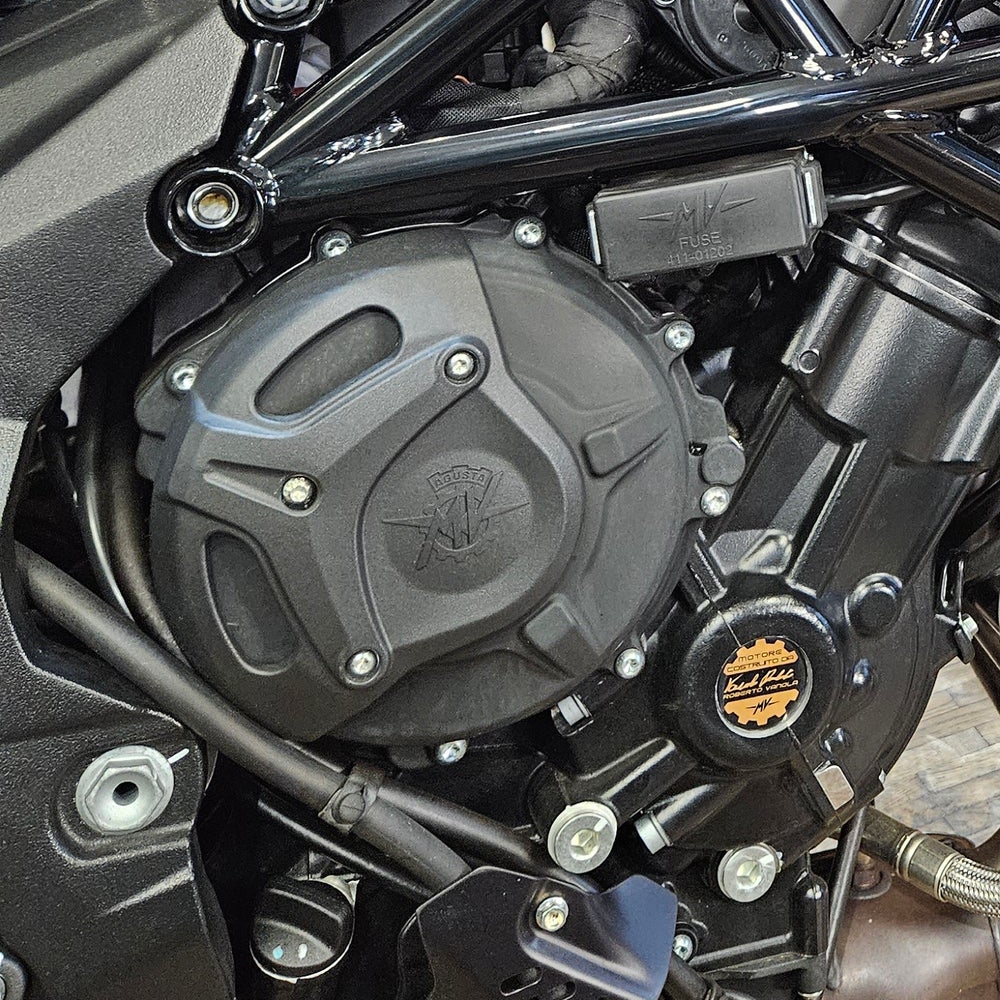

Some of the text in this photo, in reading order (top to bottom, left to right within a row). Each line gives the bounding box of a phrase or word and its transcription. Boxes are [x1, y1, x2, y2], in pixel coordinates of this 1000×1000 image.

[678, 230, 723, 250] FUSE
[434, 470, 487, 490] AGUSTA
[726, 654, 795, 673] COSTRUITO DA
[738, 649, 783, 662] MOTORE
[722, 686, 763, 700] ROBERTO
[765, 679, 799, 692] VANOLA
